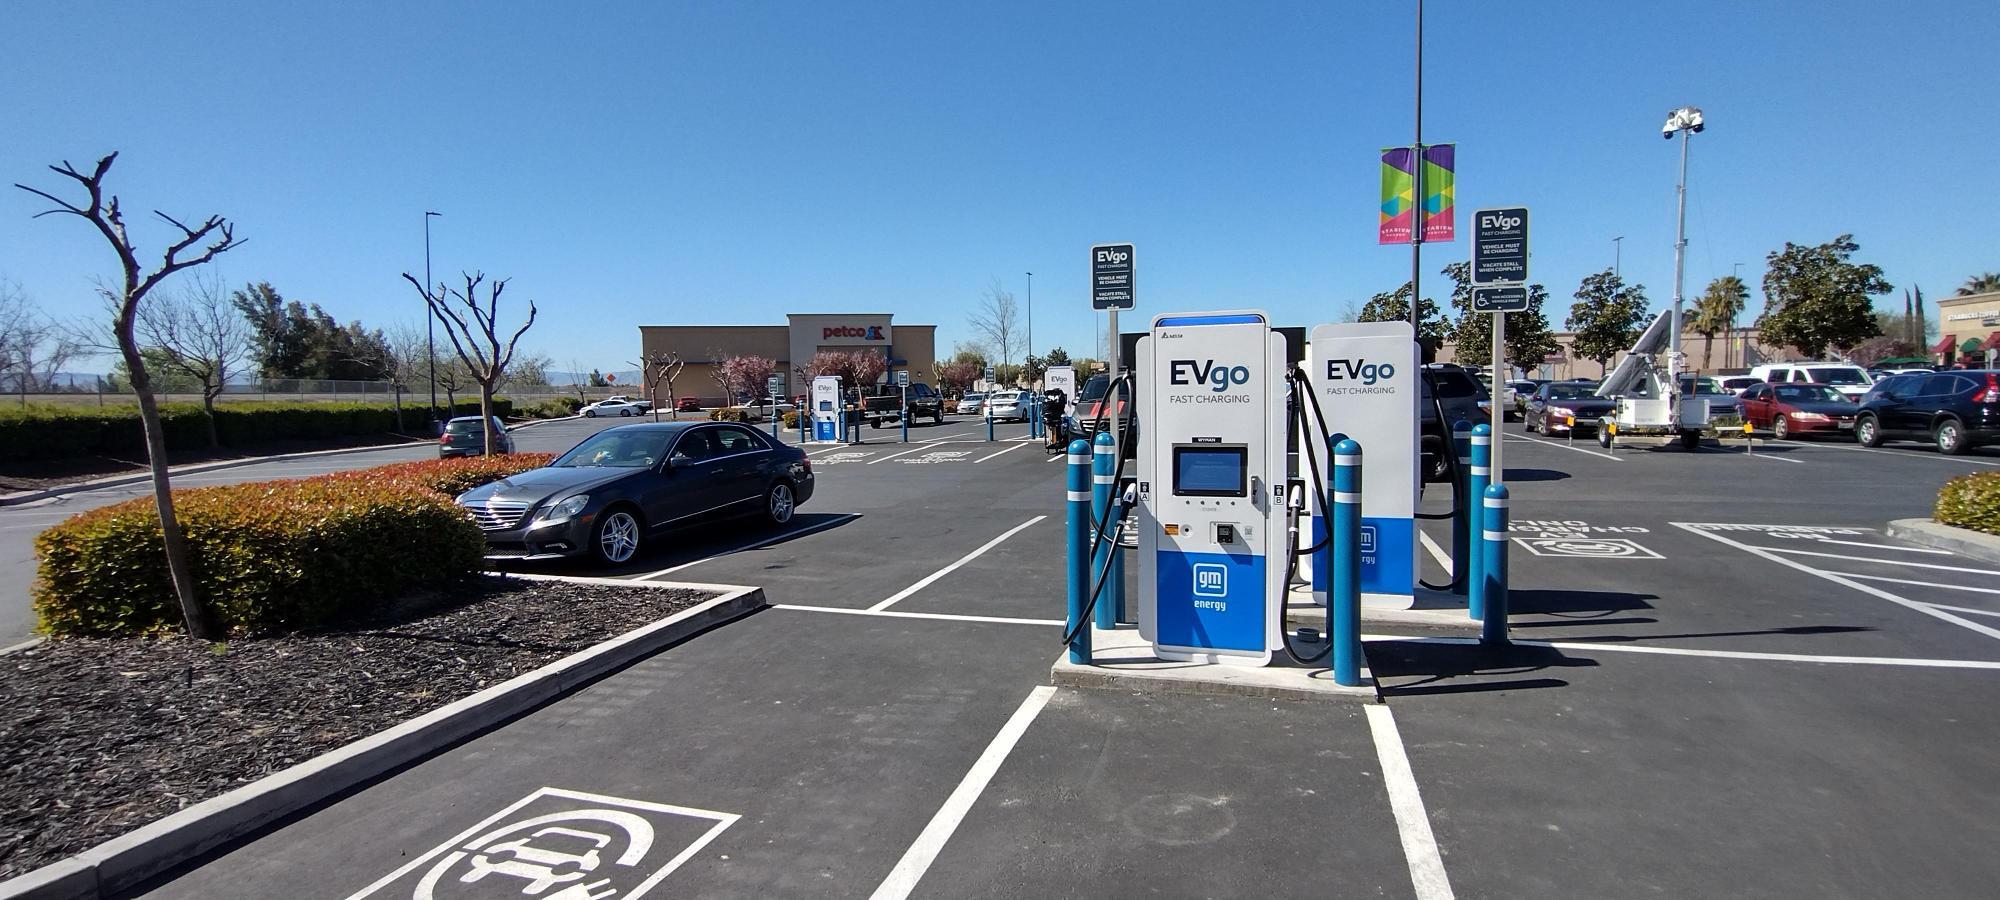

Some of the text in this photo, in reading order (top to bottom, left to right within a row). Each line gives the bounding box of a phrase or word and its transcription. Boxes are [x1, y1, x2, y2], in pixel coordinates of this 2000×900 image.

[1482, 215, 1520, 230] EVgo
[1097, 250, 1128, 264] EVgo
[823, 326, 866, 340] petco
[1170, 359, 1250, 392] EVgo
[1327, 359, 1395, 385] EVgo
[1170, 395, 1250, 404] FAST CHARGING
[1768, 532, 1831, 540] NO
[1361, 556, 1375, 565] rgy
[1199, 571, 1221, 588] gm
[1194, 600, 1226, 611] energy
